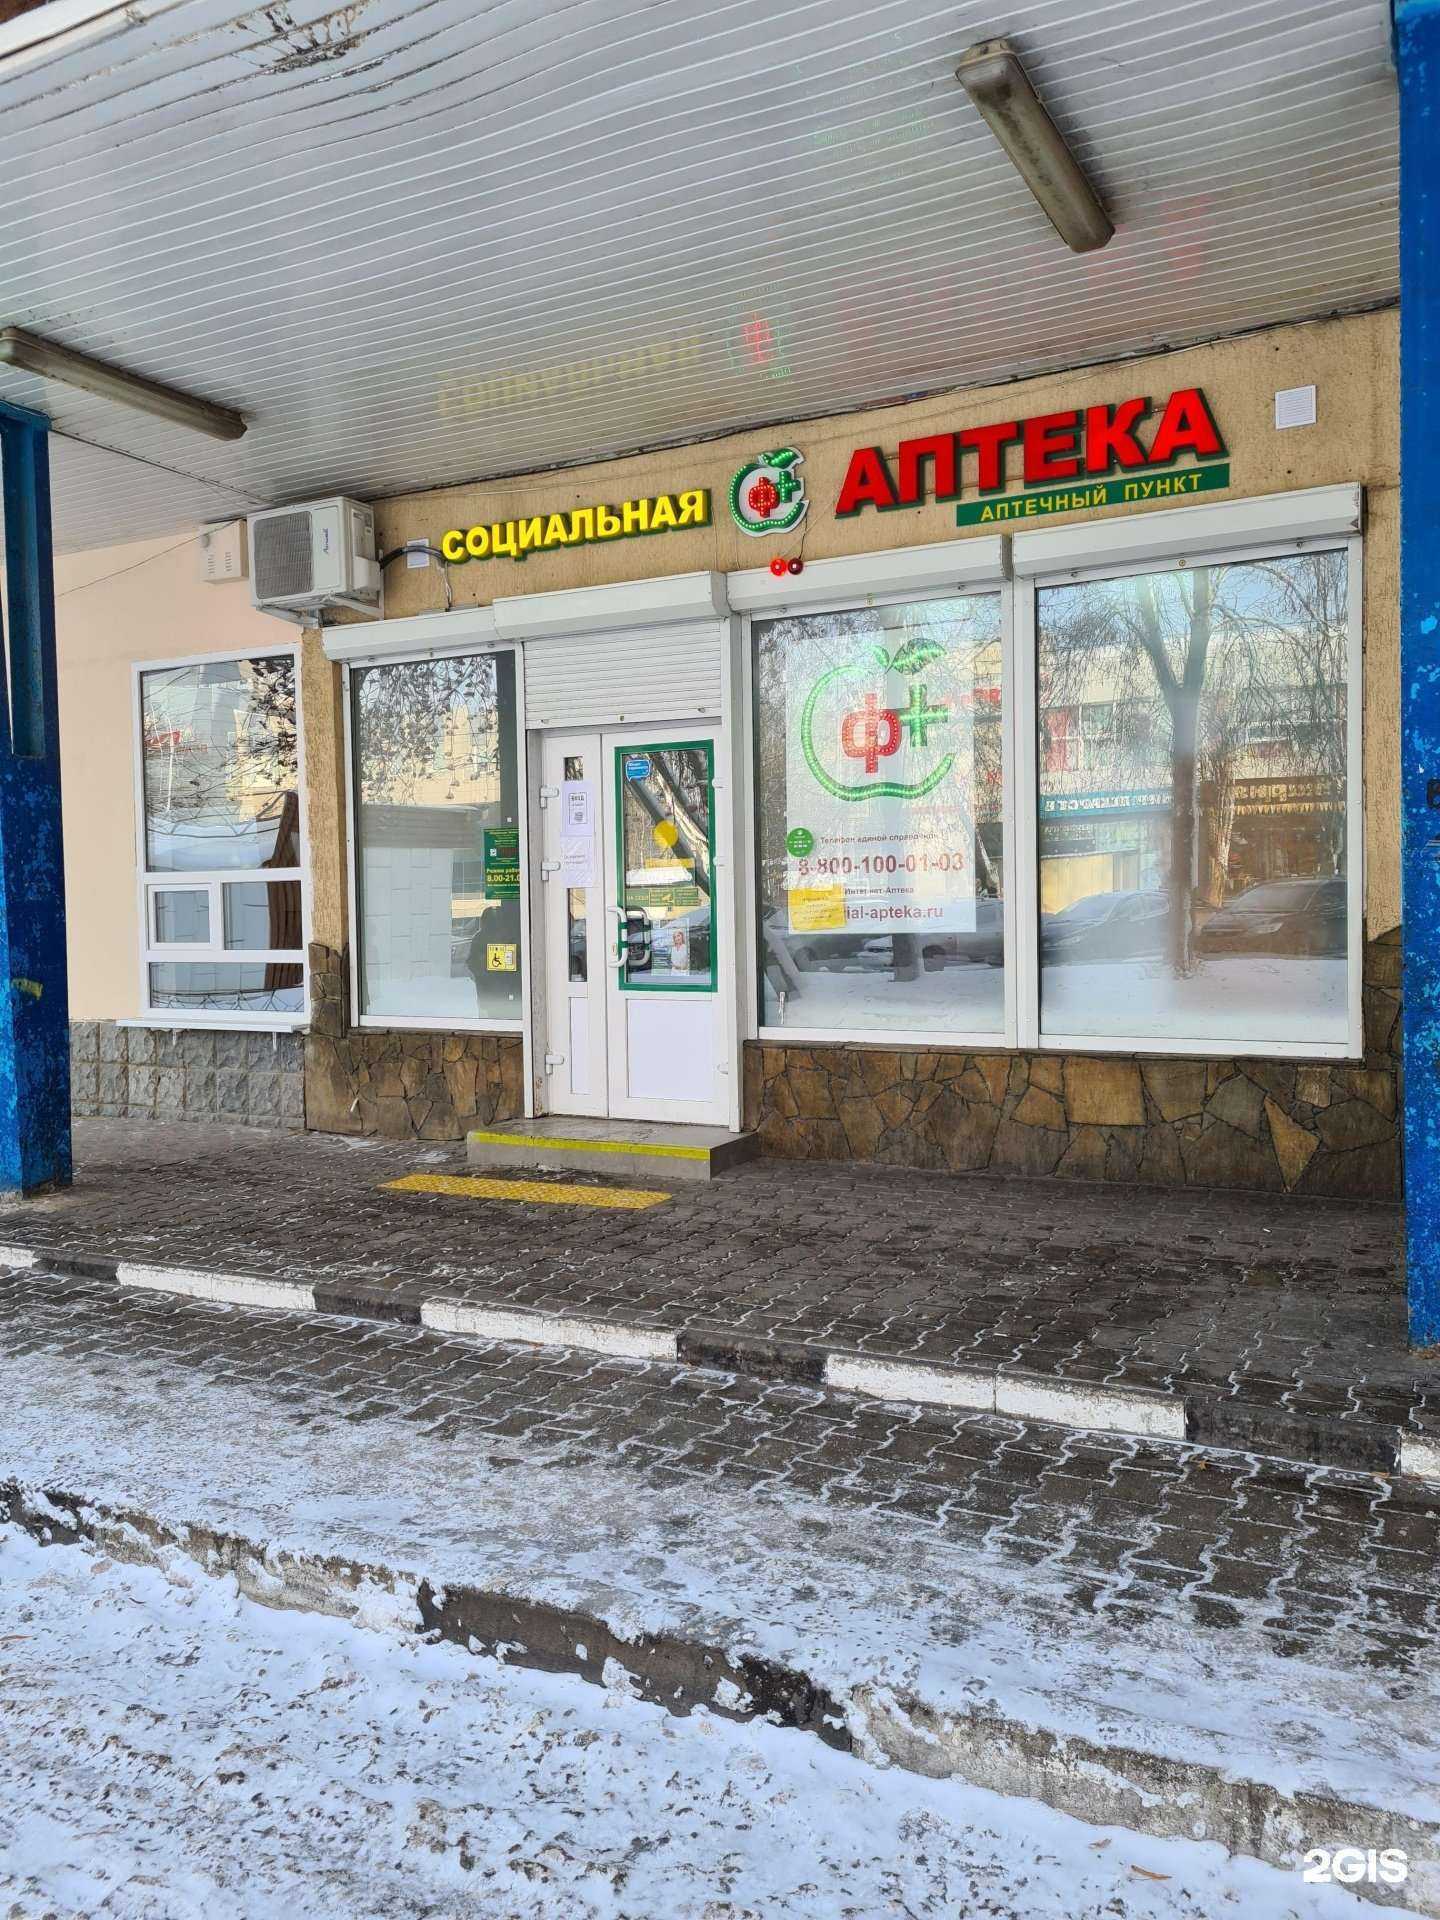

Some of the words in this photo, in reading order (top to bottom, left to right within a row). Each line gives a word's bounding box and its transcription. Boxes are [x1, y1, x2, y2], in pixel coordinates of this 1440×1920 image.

[834, 388, 1226, 518] АПТЕКА
[980, 484, 1107, 521] АПТЕЧНЫЙ
[1124, 473, 1203, 502] ПУНКТ
[441, 489, 711, 563] СОЦИАЛЬНАЯ
[798, 852, 964, 875] 8-800-100-01-03
[845, 905, 944, 921] ial-apteka.ru
